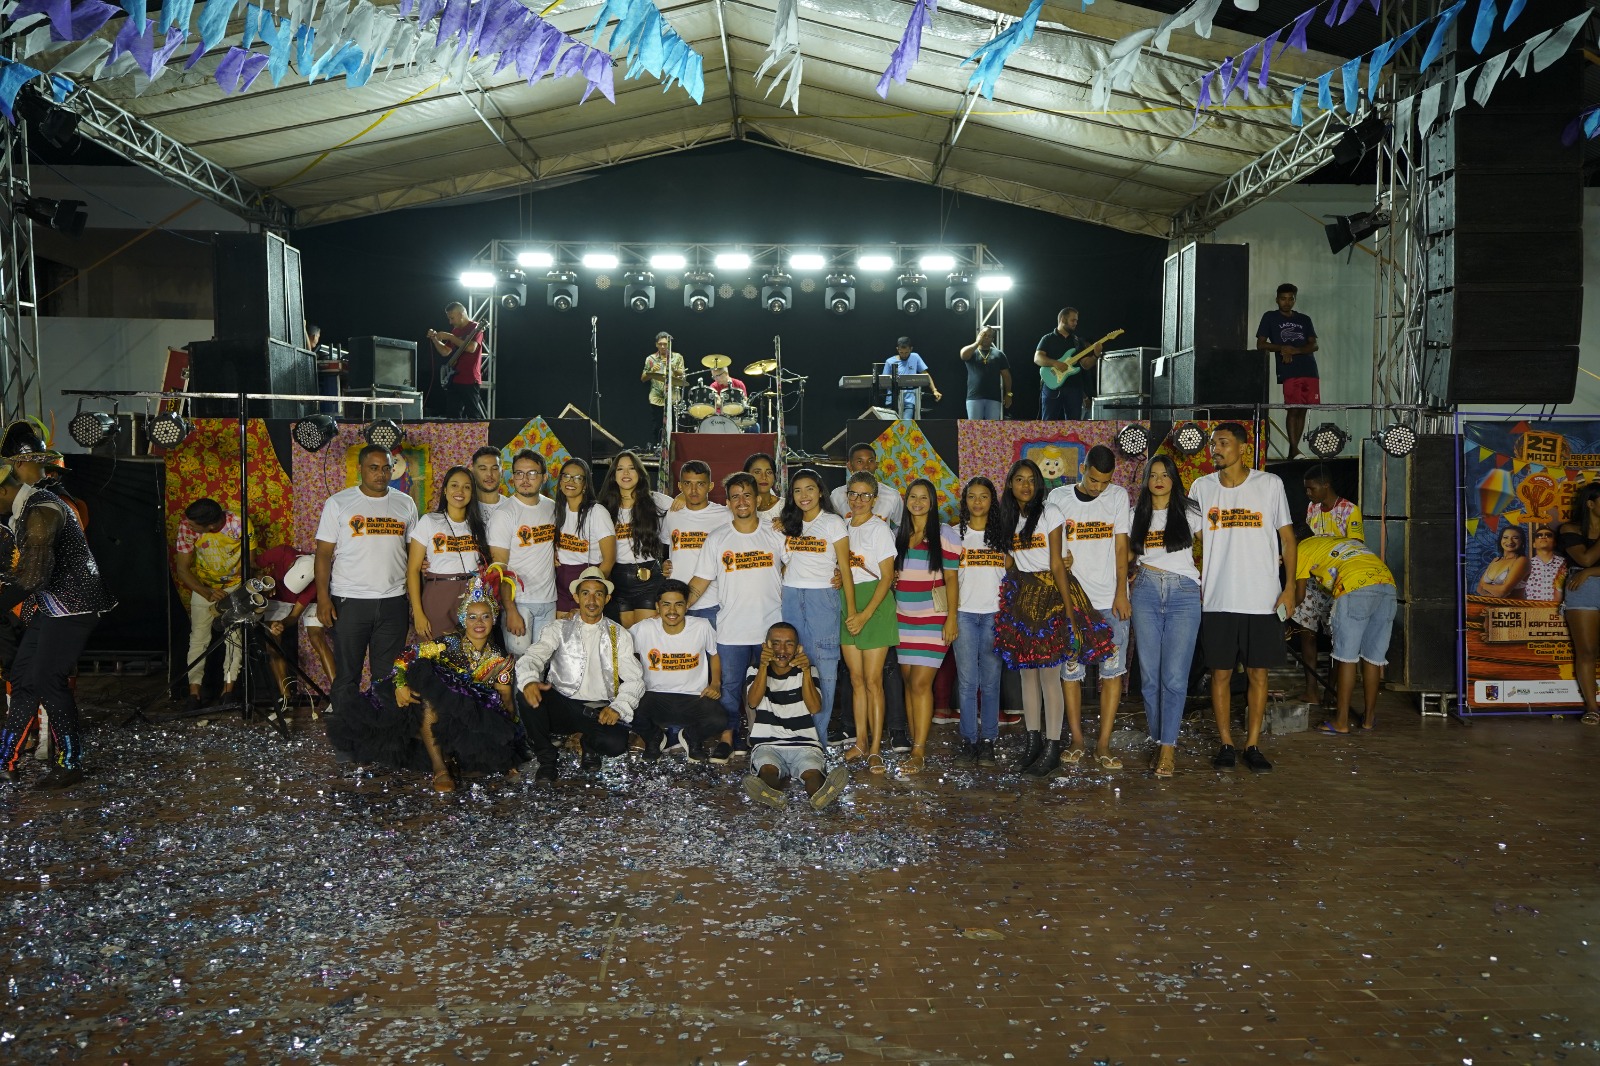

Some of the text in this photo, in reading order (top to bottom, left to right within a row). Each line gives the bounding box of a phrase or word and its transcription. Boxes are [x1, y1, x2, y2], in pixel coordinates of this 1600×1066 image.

[1527, 436, 1557, 452] 29
[1527, 453, 1557, 462] MAIO
[1492, 620, 1522, 628] SOUSA
